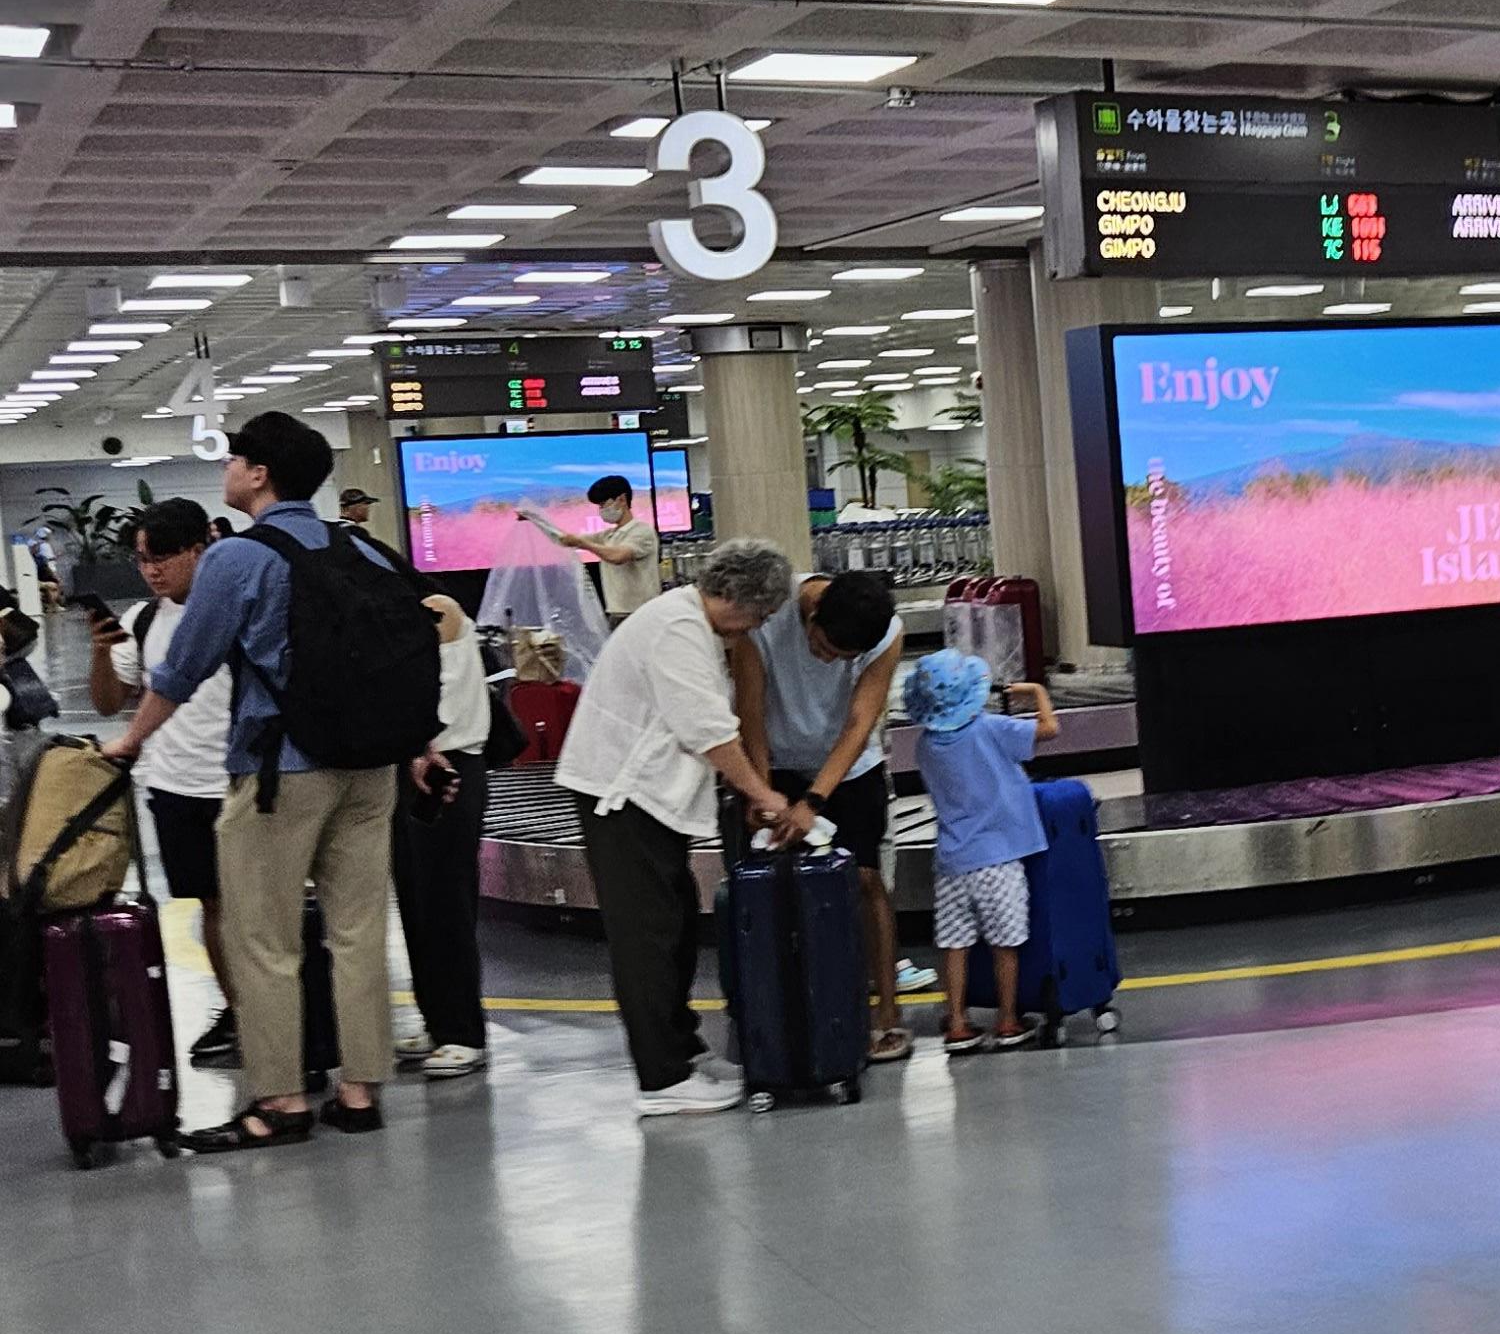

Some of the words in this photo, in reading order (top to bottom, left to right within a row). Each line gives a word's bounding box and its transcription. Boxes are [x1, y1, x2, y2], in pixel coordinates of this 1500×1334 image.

[1323, 111, 1341, 142] 3
[648, 110, 777, 280] 3
[1096, 190, 1187, 213] CHEONGJU
[1098, 214, 1154, 235] GIMPO
[1321, 216, 1344, 238] KE
[1100, 237, 1156, 259] GIMPO
[508, 341, 519, 355] 4
[169, 356, 229, 430] 4
[1139, 356, 1279, 410] Enjoy
[191, 414, 230, 462] 5
[414, 450, 489, 475] Enjoy
